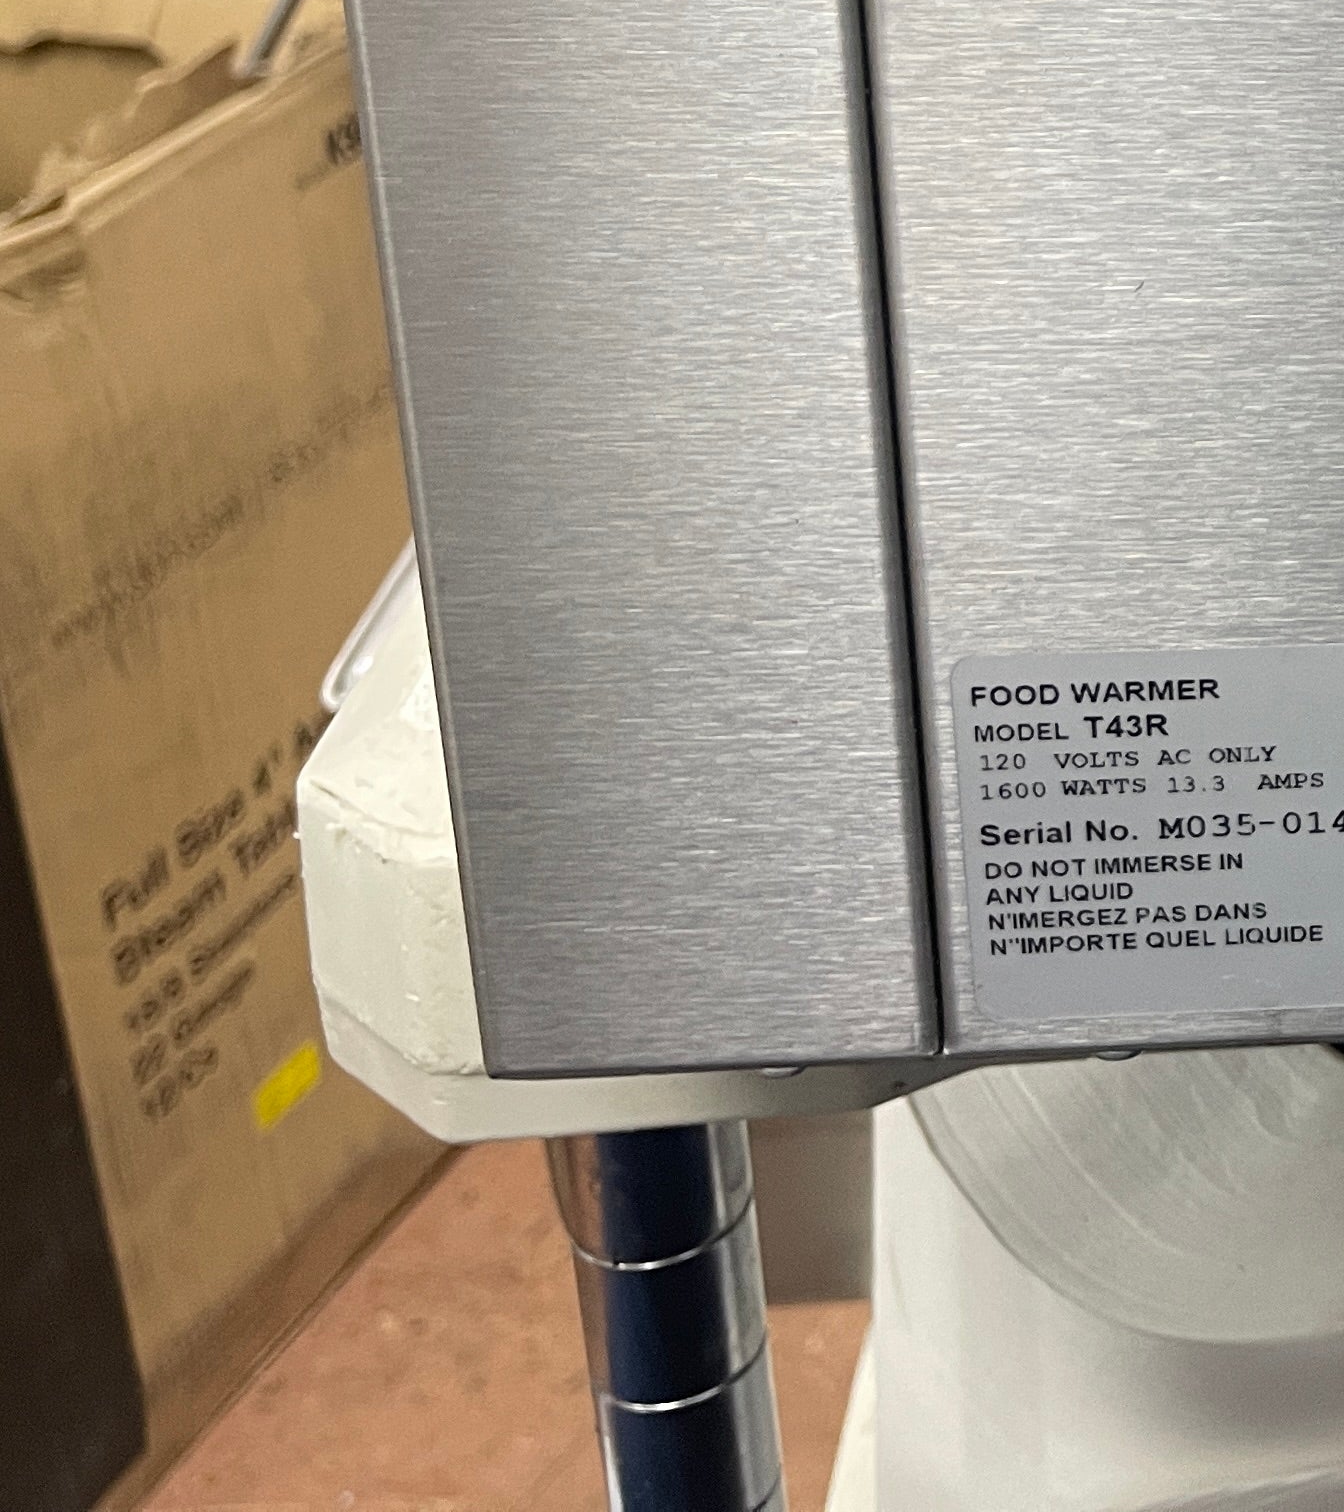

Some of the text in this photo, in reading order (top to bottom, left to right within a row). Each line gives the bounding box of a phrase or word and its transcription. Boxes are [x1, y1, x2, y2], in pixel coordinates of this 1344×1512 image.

[971, 679, 1220, 707] FOOD WARMER
[974, 714, 1168, 742] MODEL T43R
[980, 745, 1276, 771] 120 VOLTS AC ONLY
[980, 772, 1324, 801] 1600 WATTS 13.3 AMPS
[980, 821, 1071, 846] Serial
[1086, 819, 1138, 842] No.
[985, 853, 1243, 880] DO NOT IMMERSE IN
[986, 883, 1133, 906] ANY LIQUID
[989, 903, 1267, 930] N'IMERGEZ PAS DANS
[1145, 930, 1216, 949] QUEL
[1225, 925, 1323, 945] LIQUIDE
